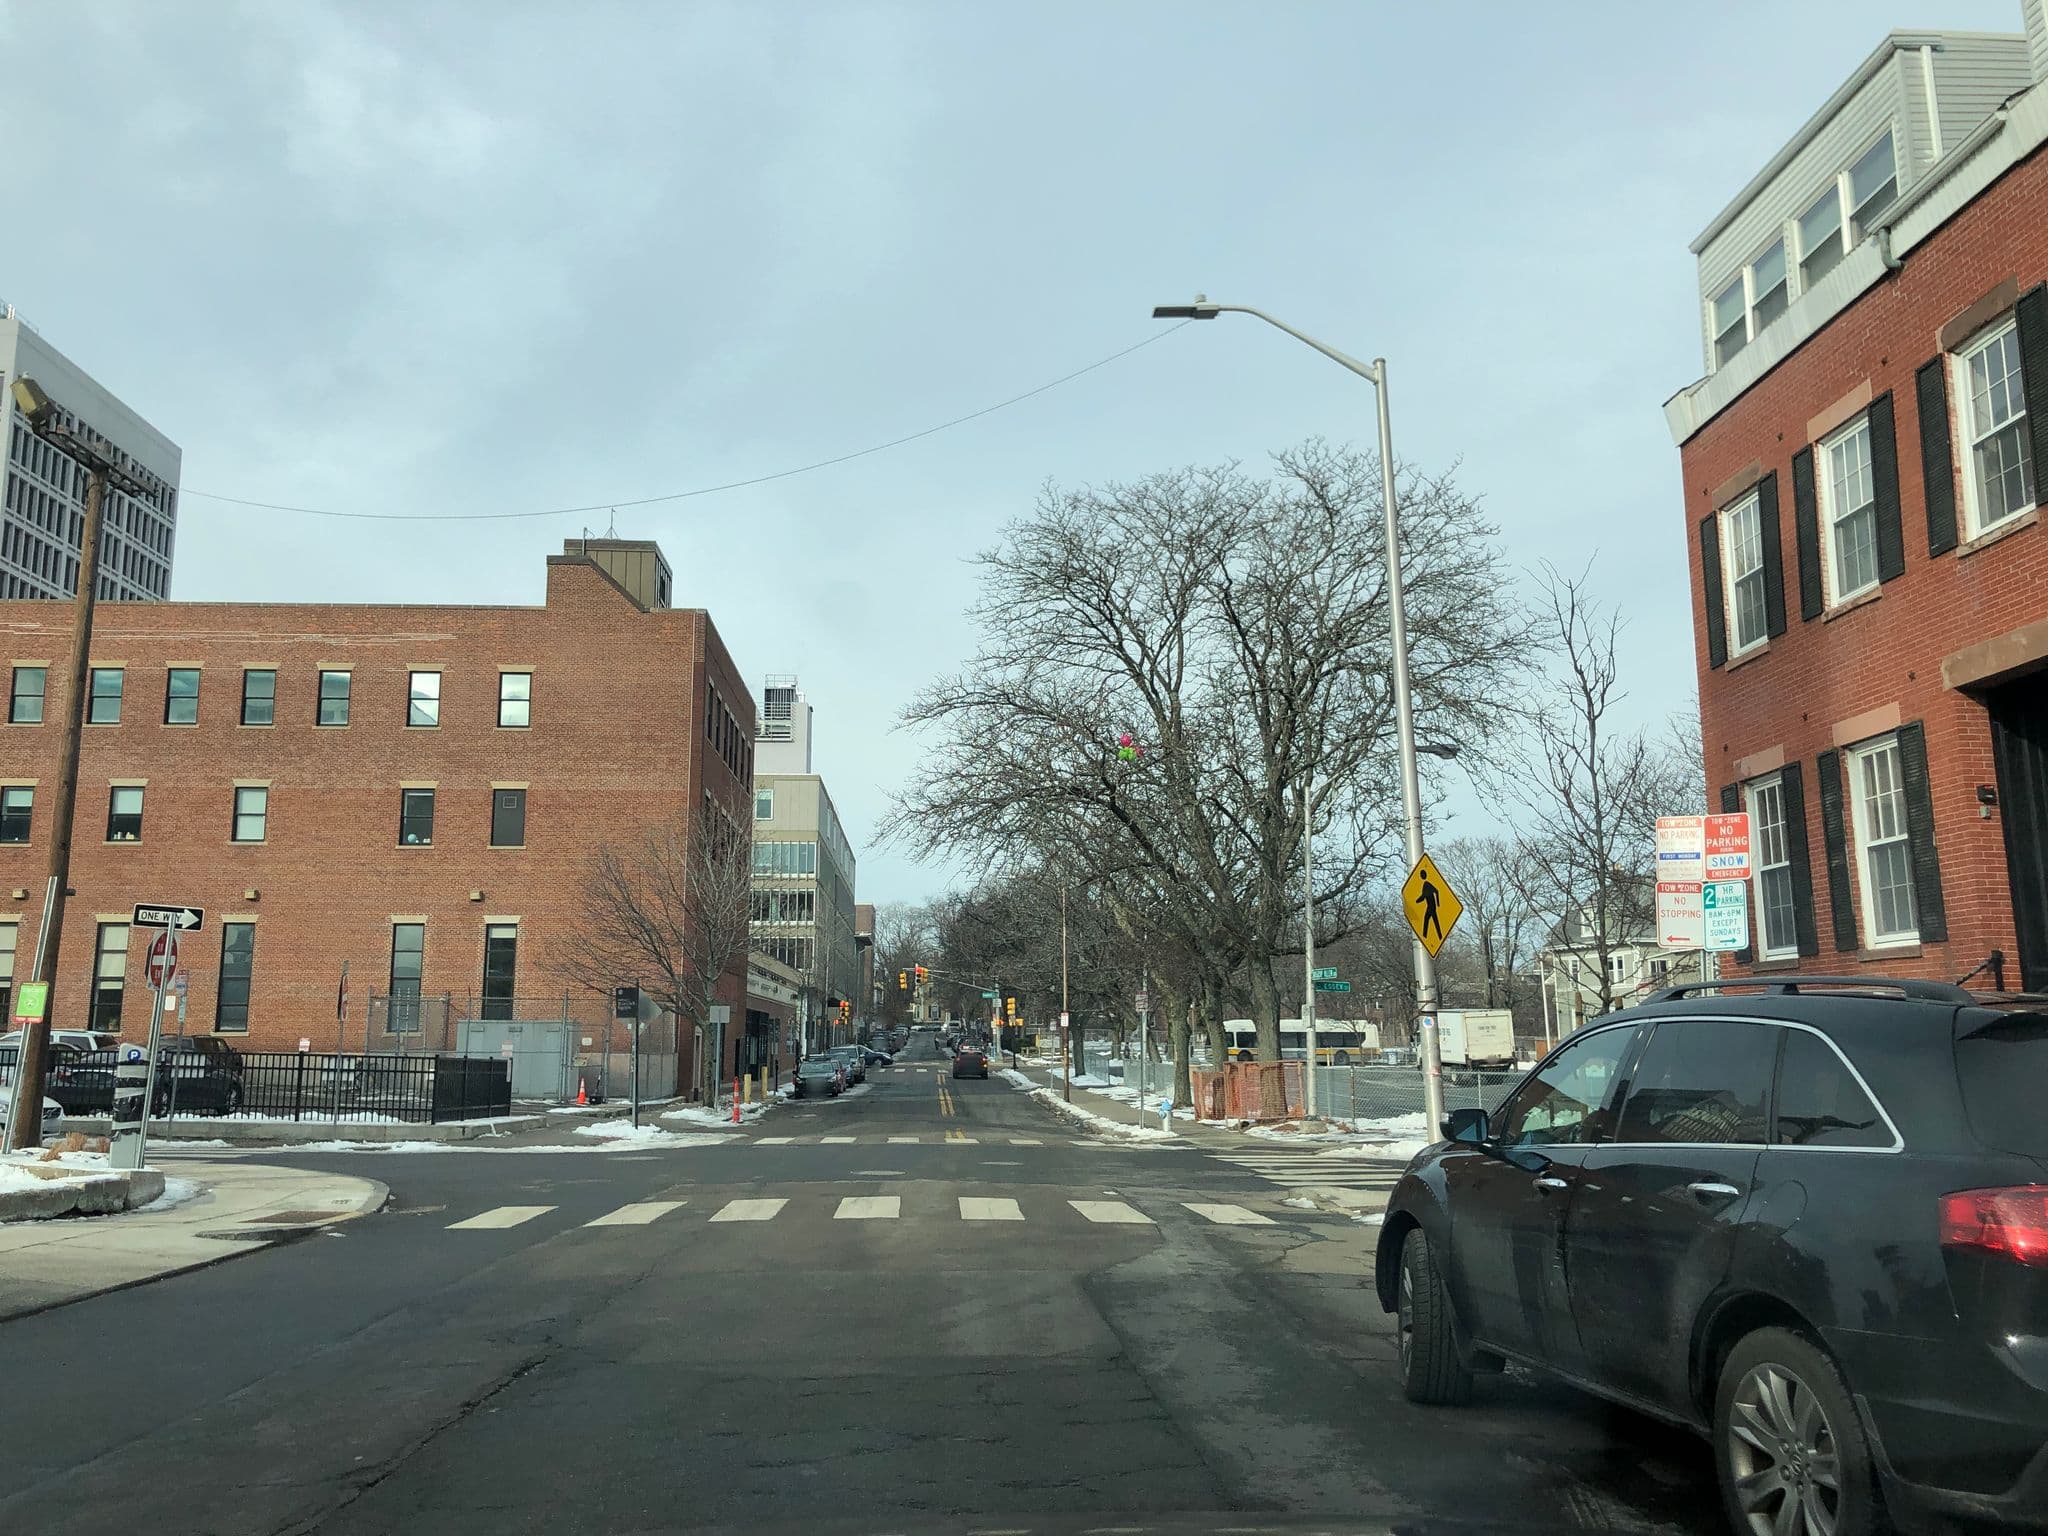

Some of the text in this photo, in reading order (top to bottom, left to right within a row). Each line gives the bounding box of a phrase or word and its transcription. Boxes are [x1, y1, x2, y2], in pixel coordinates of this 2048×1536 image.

[1720, 825, 1733, 835] NO
[1660, 831, 1669, 840] NO
[1706, 836, 1748, 848] PARKING
[1712, 856, 1744, 867] SNOW
[1712, 869, 1744, 877] EMERGENCY
[1661, 884, 1699, 892] TOW ZONE
[1704, 886, 1734, 904] 2 HR
[1674, 896, 1686, 905] NO
[1716, 895, 1744, 905] PARKING
[141, 911, 182, 922] ONE WY
[1660, 909, 1701, 918] STOPPING
[1712, 918, 1737, 927] EXCEPT
[1709, 928, 1741, 936] SUNDAYS
